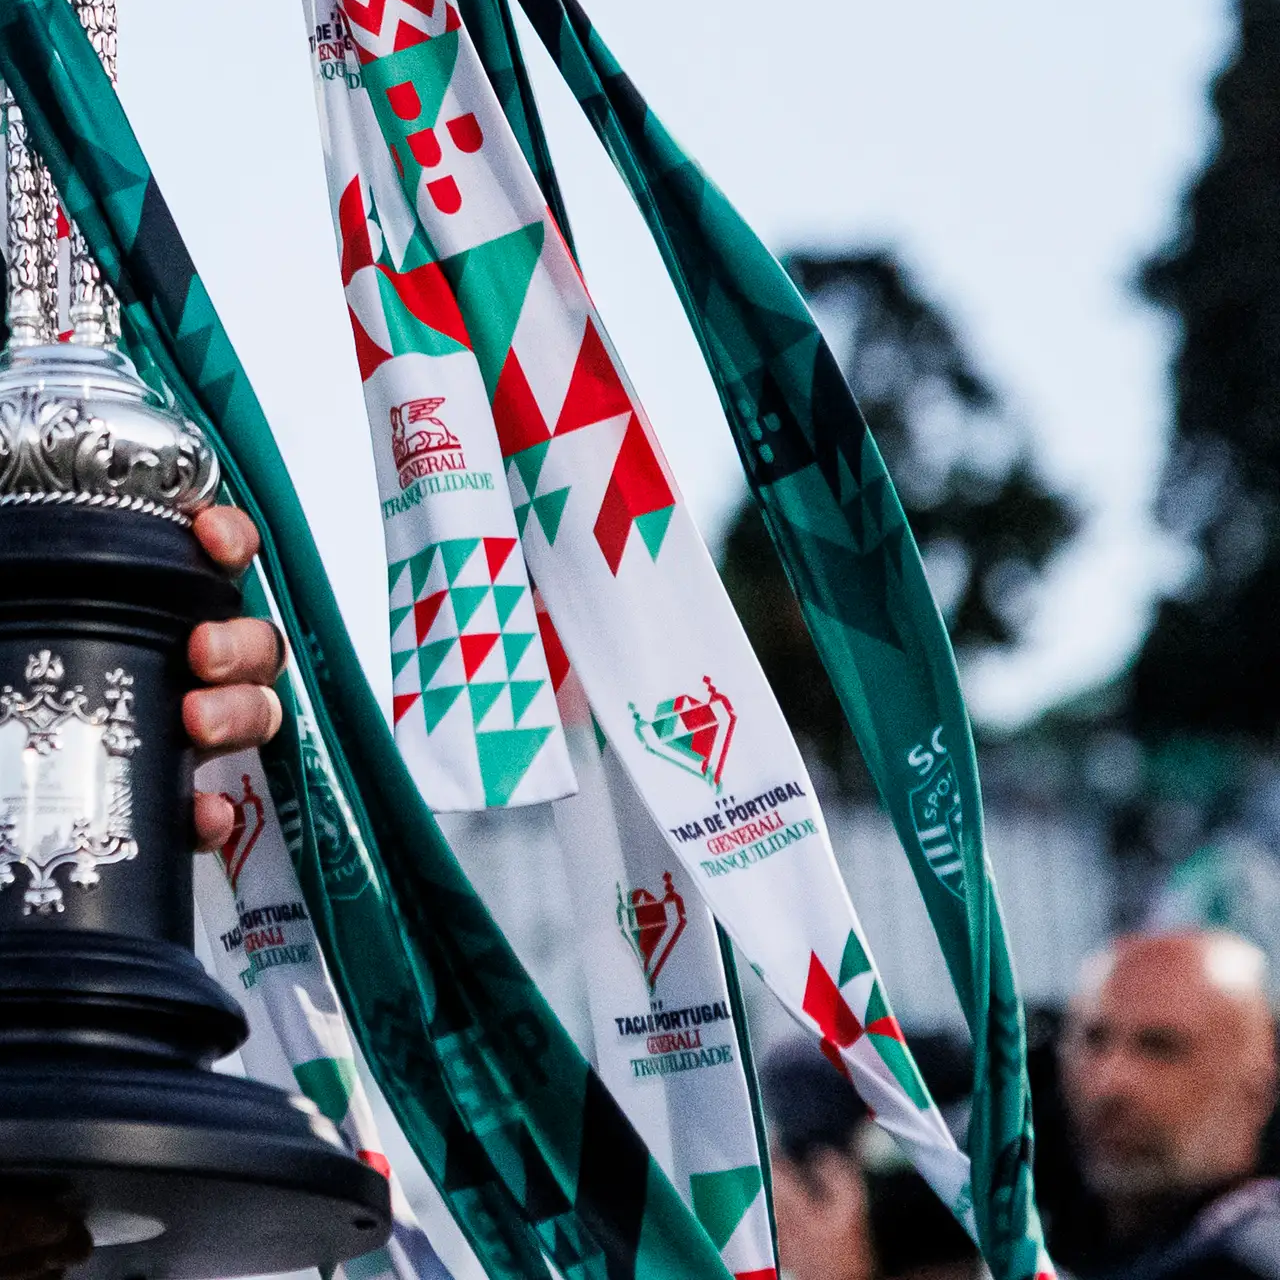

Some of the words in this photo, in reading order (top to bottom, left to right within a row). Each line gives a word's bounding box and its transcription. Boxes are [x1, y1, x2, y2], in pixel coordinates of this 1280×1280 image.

[669, 821, 706, 843] TAÇA
[703, 812, 726, 835] DE
[725, 781, 806, 827] PORTUGAL
[706, 809, 785, 856] GENERALI
[700, 818, 819, 878] TRANQUILIDADE
